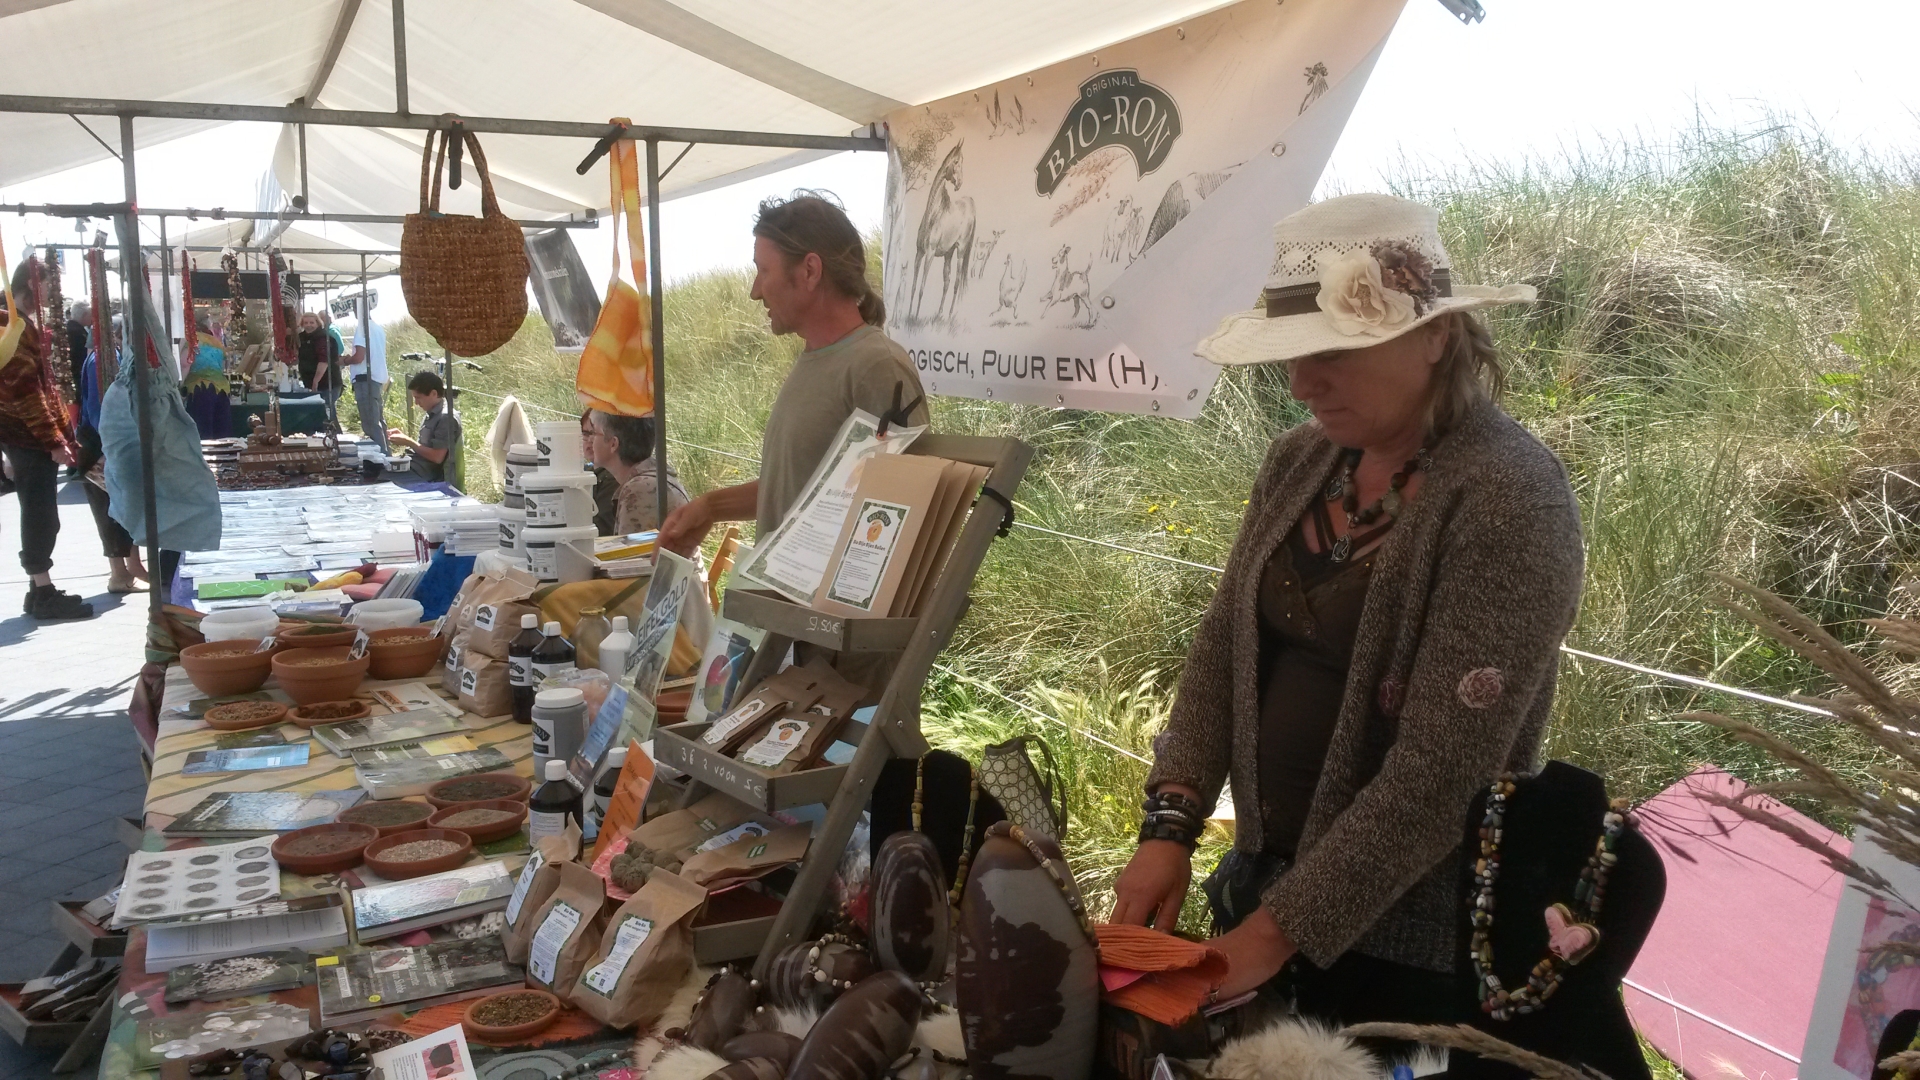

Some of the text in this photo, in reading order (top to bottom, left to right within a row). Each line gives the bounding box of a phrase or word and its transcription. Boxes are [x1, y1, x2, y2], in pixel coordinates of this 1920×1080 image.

[1086, 76, 1135, 98] ORIGINAL
[1046, 95, 1171, 186] BIO-RON
[982, 349, 1047, 381] PUUR
[1056, 356, 1097, 383] EN
[703, 757, 709, 771] 2
